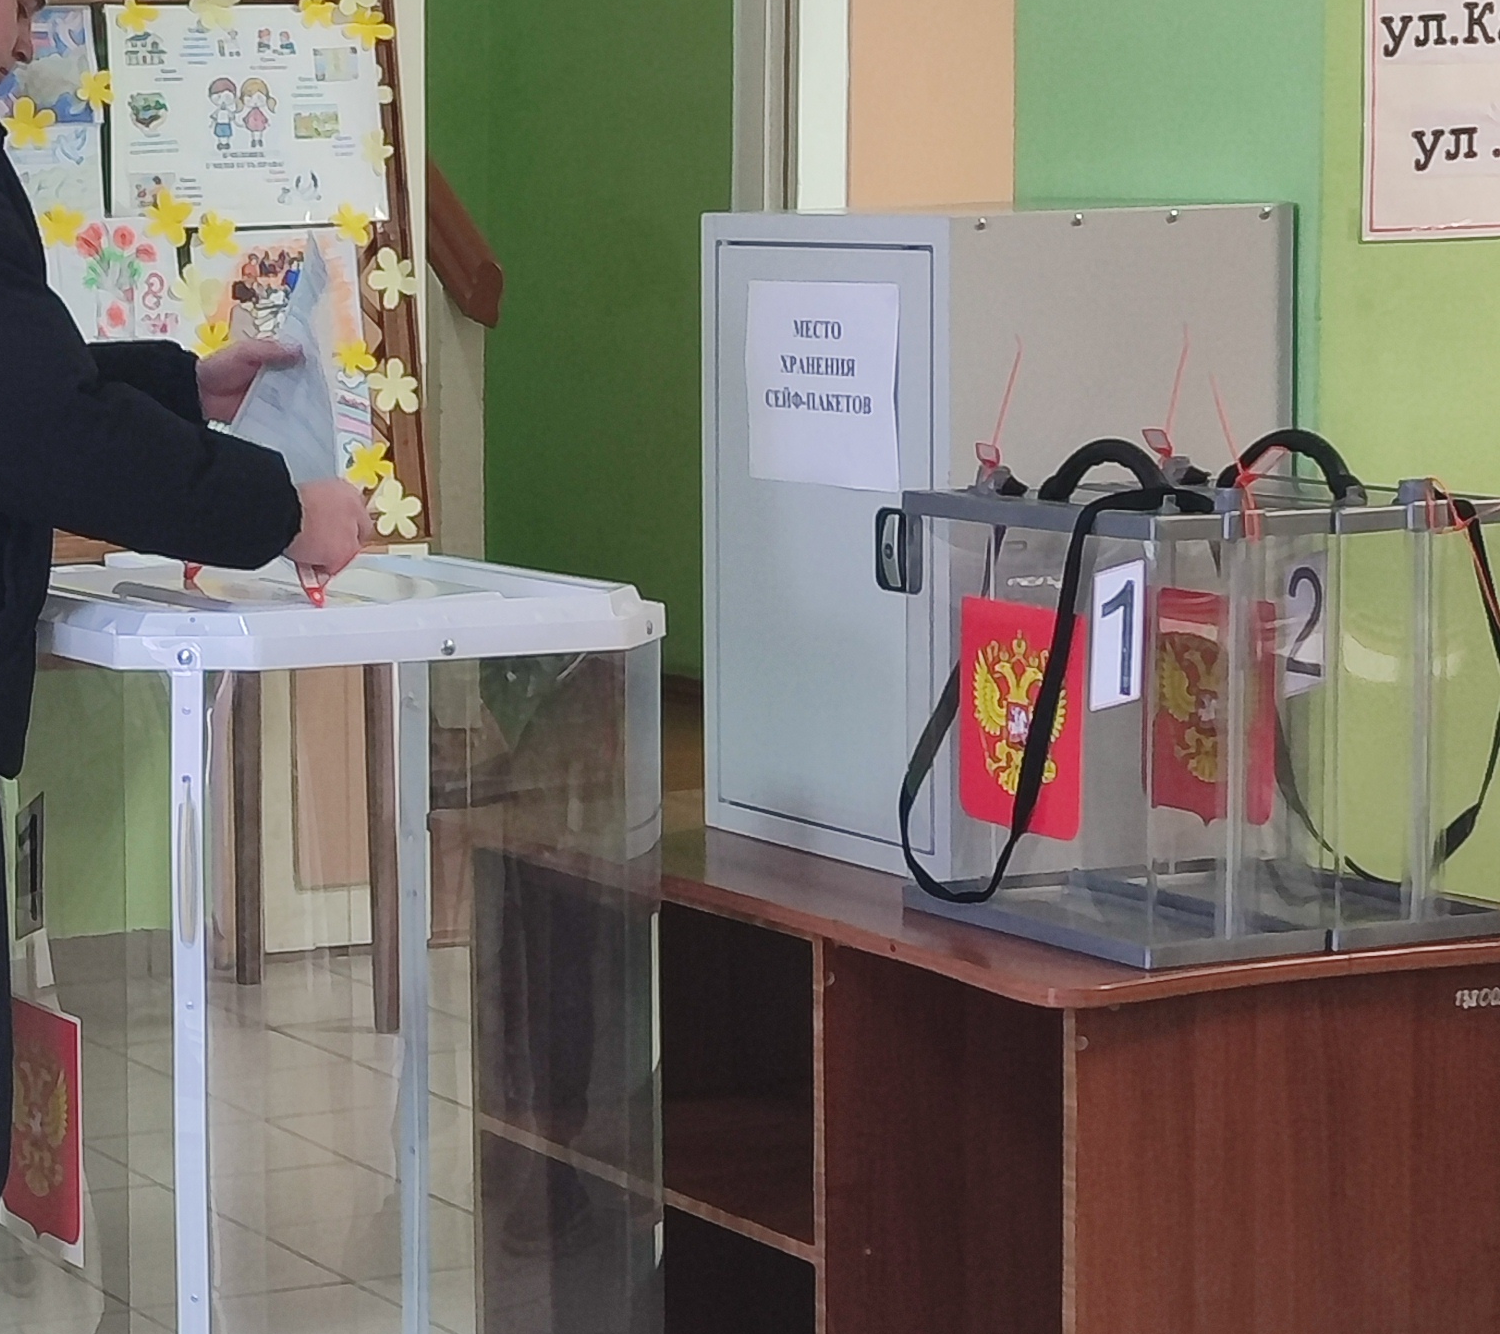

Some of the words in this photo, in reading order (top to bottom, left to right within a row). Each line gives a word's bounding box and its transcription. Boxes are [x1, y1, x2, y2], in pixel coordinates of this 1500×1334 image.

[1380, 1, 1500, 58] ул.К
[793, 319, 842, 340] МЕСТО
[780, 354, 856, 377] ХРАНЕНИЯ
[764, 386, 872, 415] СЕЙФ-ПАКЕТОВ
[1100, 578, 1135, 697] 1
[1285, 566, 1323, 678] 2
